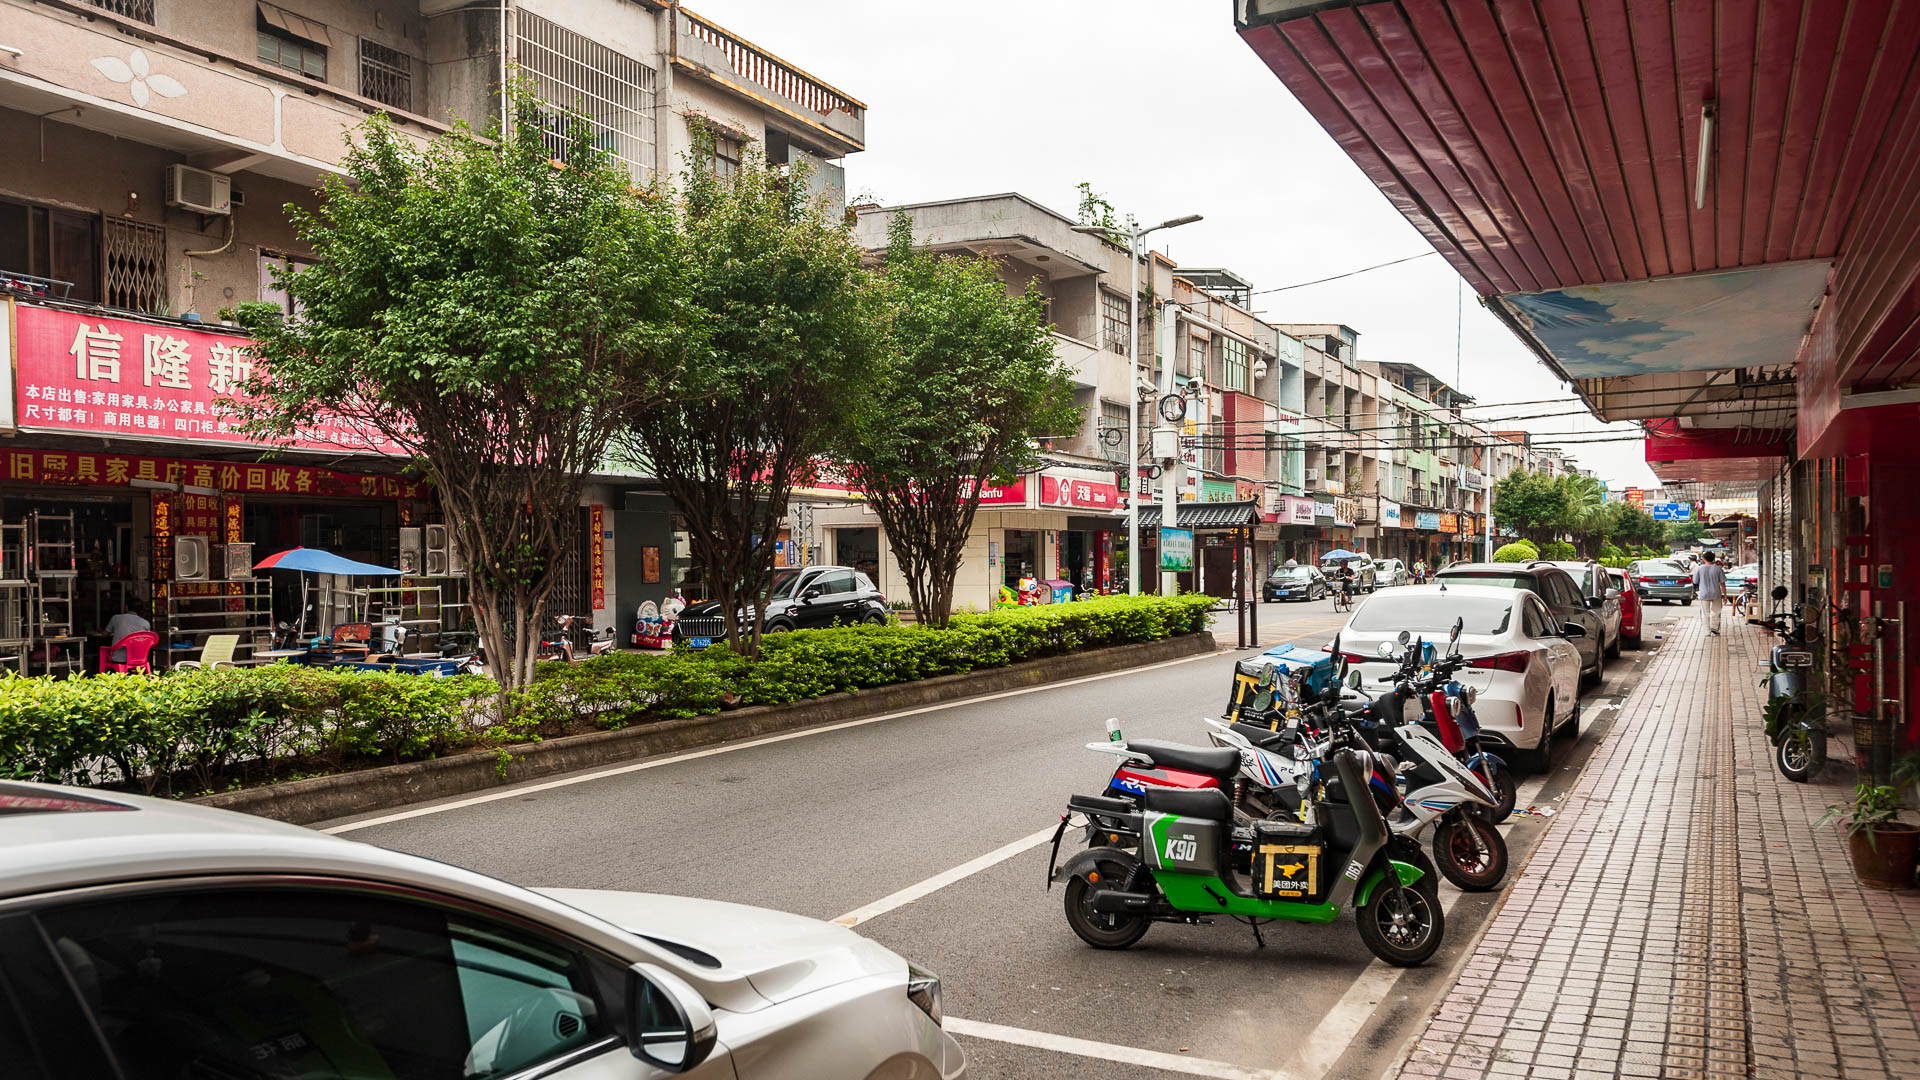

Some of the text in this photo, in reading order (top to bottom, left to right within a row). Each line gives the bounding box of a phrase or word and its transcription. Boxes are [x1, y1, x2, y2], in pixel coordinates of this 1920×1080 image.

[1164, 838, 1197, 862] K90
[1344, 859, 1364, 881] K90
[1272, 879, 1309, 890] 美团外卖
